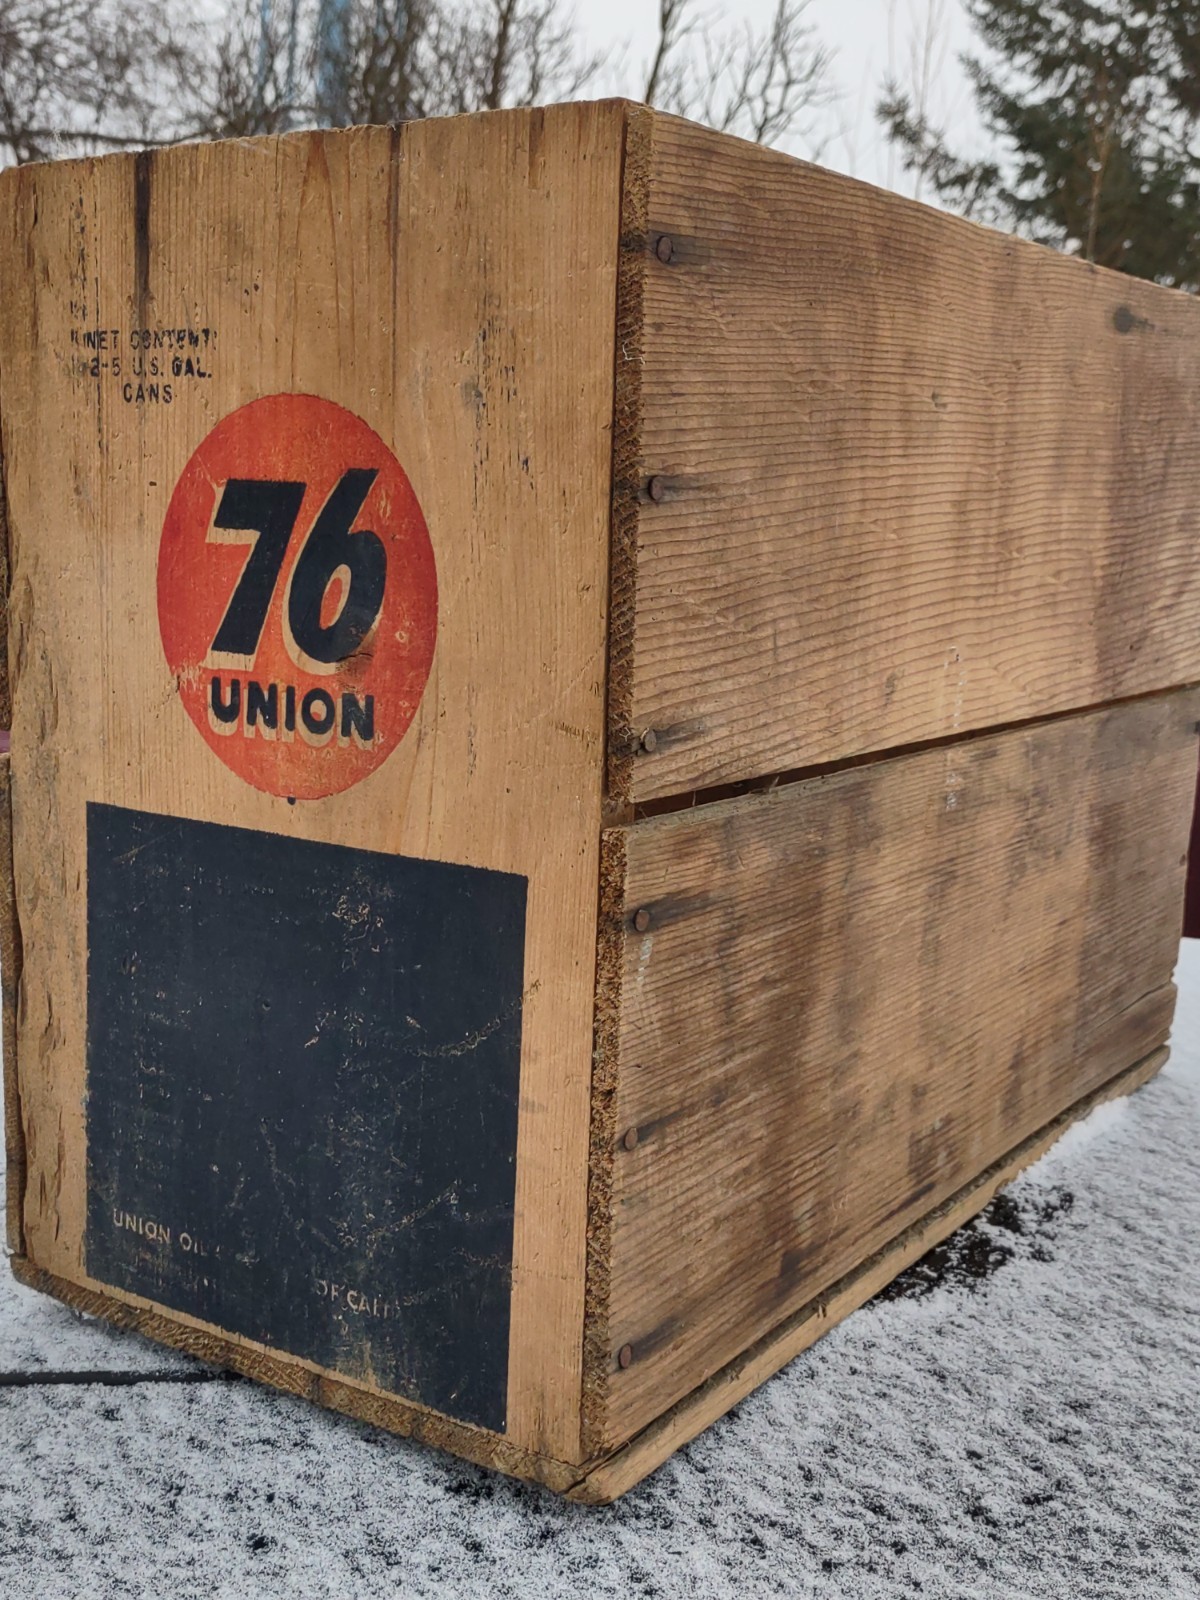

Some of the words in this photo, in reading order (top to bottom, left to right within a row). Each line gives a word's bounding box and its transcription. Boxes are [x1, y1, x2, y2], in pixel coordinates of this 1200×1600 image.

[84, 330, 120, 350] NET
[171, 355, 212, 378] GAL.
[123, 382, 173, 404] CANS
[204, 468, 388, 674] 76
[207, 677, 376, 749] UNION
[113, 1208, 171, 1244] UNION
